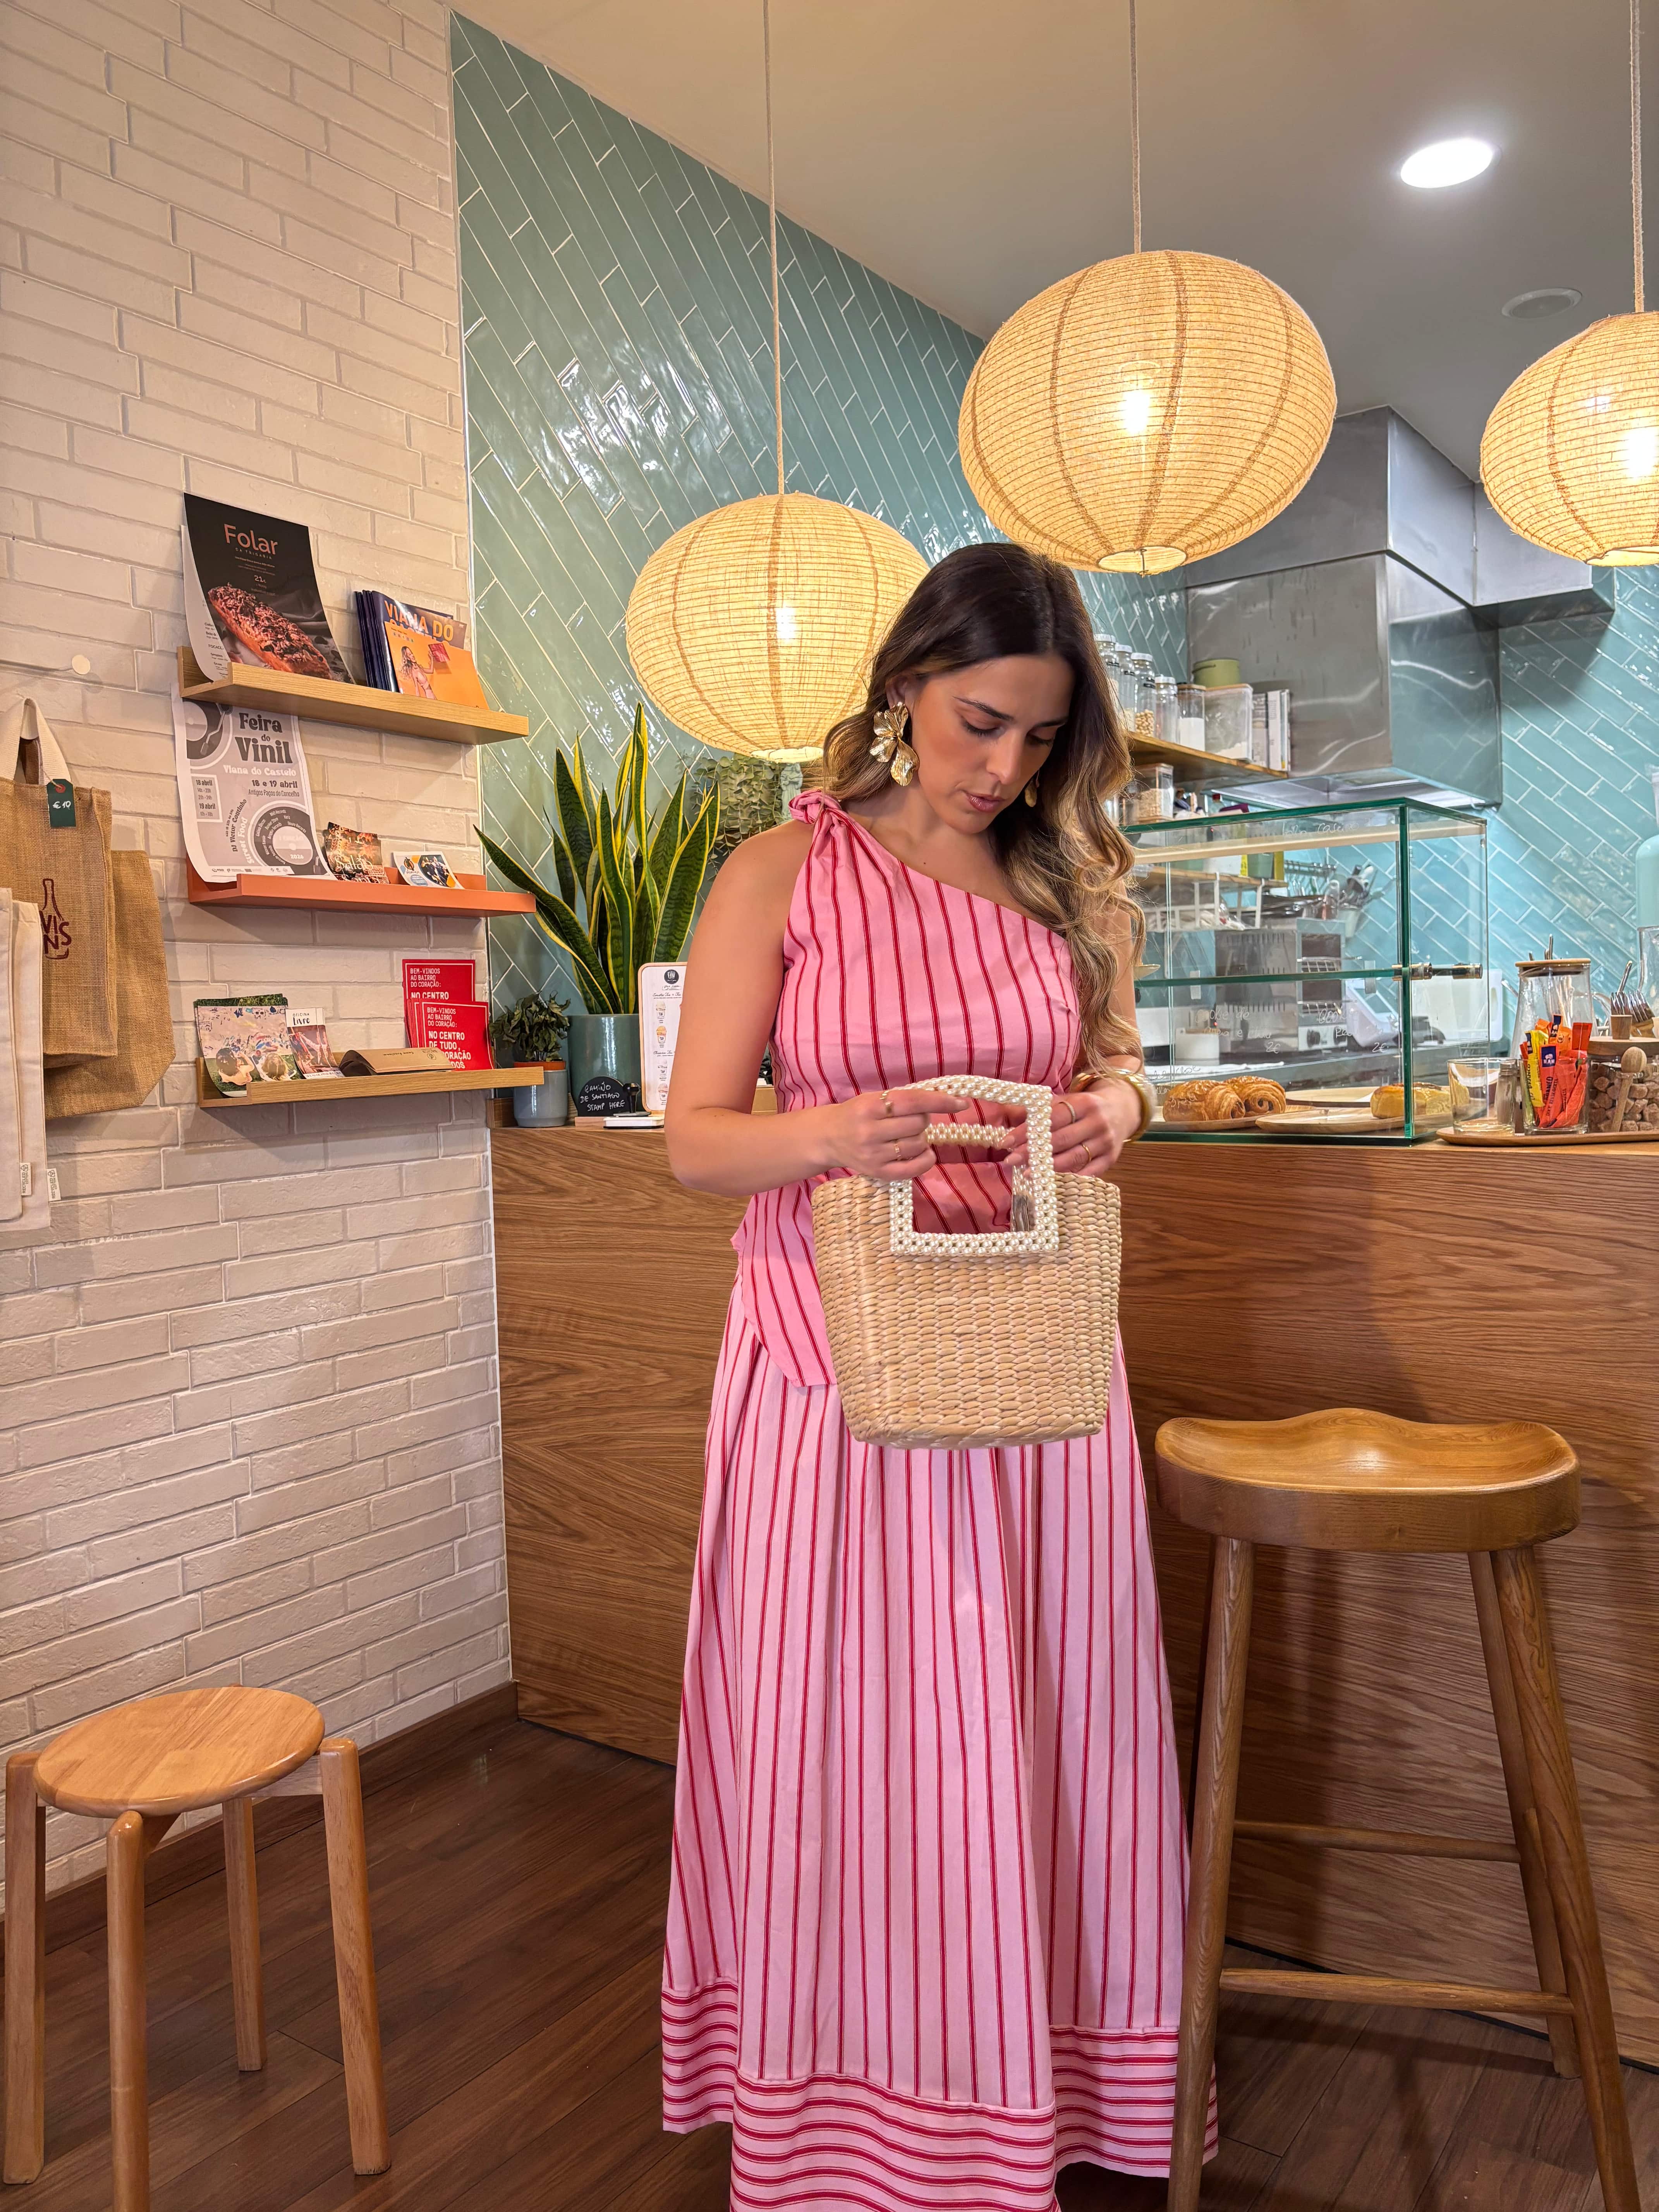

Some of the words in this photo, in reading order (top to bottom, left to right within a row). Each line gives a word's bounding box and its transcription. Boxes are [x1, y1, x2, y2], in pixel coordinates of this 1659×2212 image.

[224, 524, 278, 555] Folar
[384, 600, 429, 634] VIANA
[433, 620, 454, 641] DO
[239, 712, 283, 733] Feira
[235, 737, 293, 763] Vinil
[223, 764, 248, 774] Viana
[251, 766, 262, 775] do
[264, 768, 297, 776] Castelo
[232, 799, 247, 823] Coutinho
[237, 816, 248, 838] Food
[239, 840, 254, 864] Street
[418, 980, 441, 988] CORAÇÃO:
[422, 991, 449, 1000] CENTRO
[293, 1017, 310, 1026] Livre
[435, 1020, 457, 1028] CORAÇÃO:
[428, 1030, 438, 1039] NO
[439, 1031, 465, 1041] CENTRO
[1266, 1041, 1280, 1053] 2€
[445, 1050, 471, 1062] ORAÇÃO
[587, 1102, 605, 1111] STAMP
[609, 1099, 625, 1109] HERE
